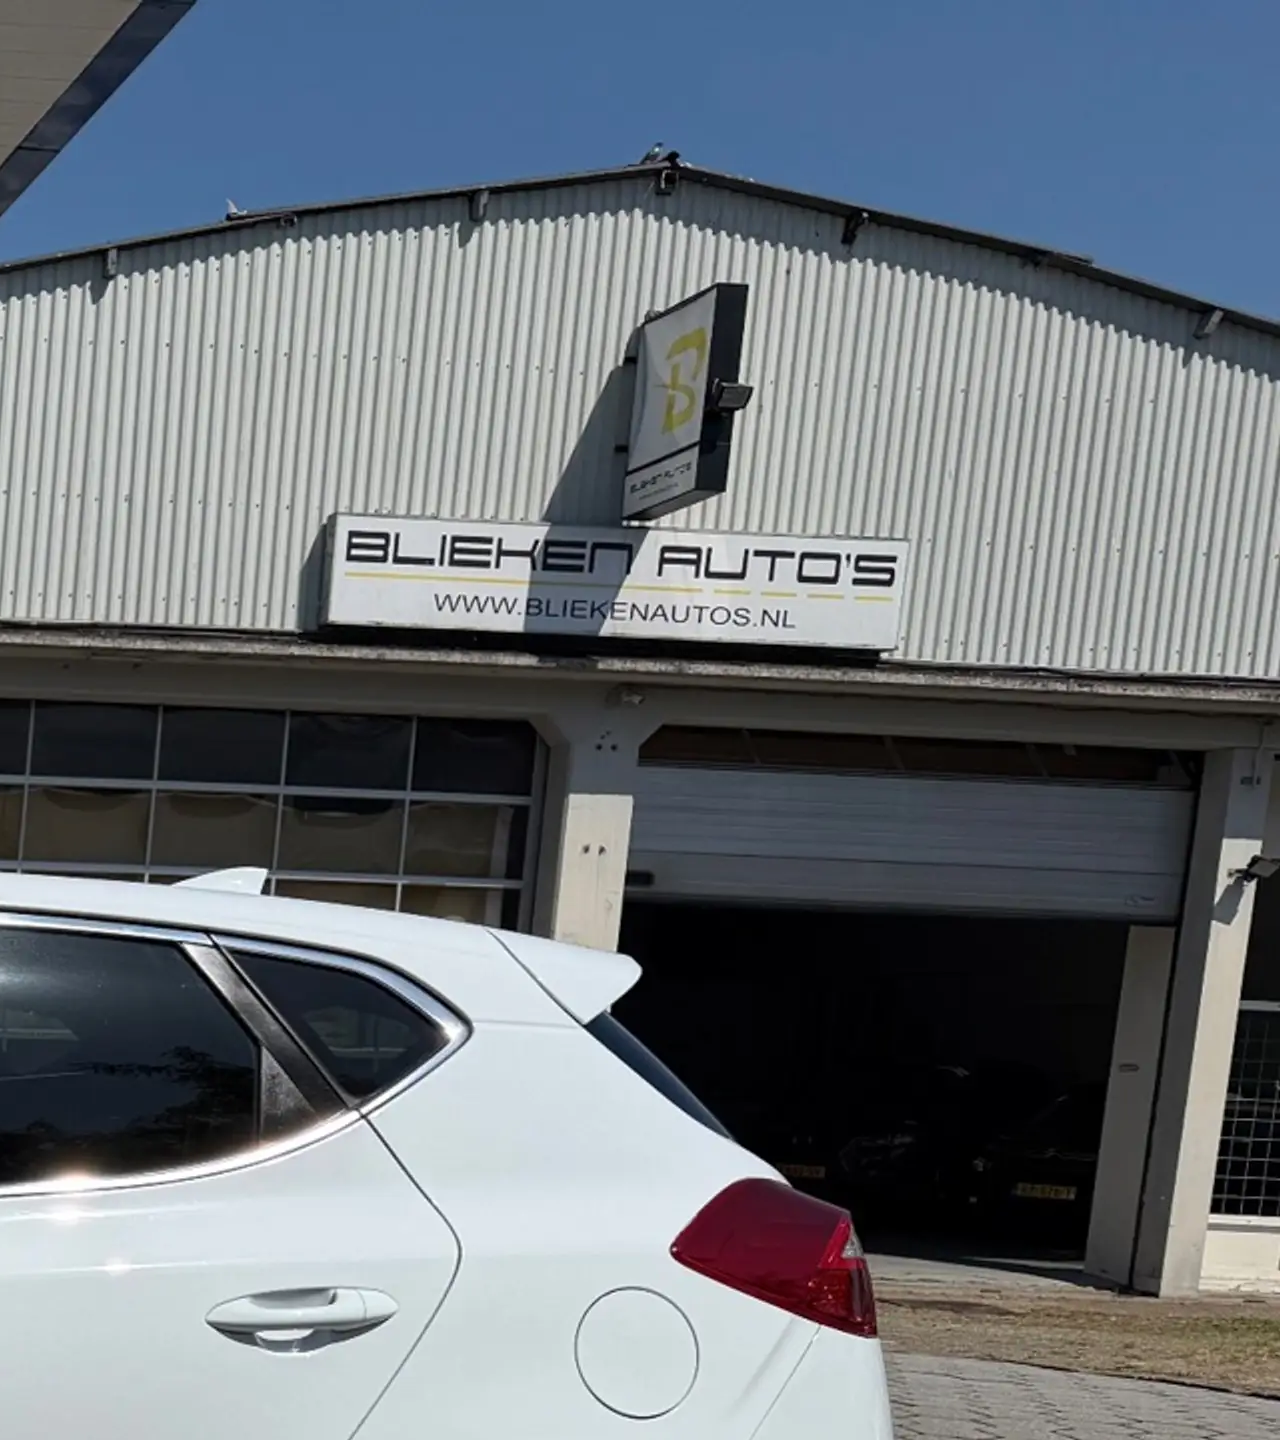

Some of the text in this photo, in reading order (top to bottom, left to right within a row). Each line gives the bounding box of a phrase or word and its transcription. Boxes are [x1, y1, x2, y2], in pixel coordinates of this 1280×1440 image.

[345, 530, 898, 587] BLIEKEN AUTO'S
[434, 592, 796, 629] WWW.BLIEKENAUTOS.NL
